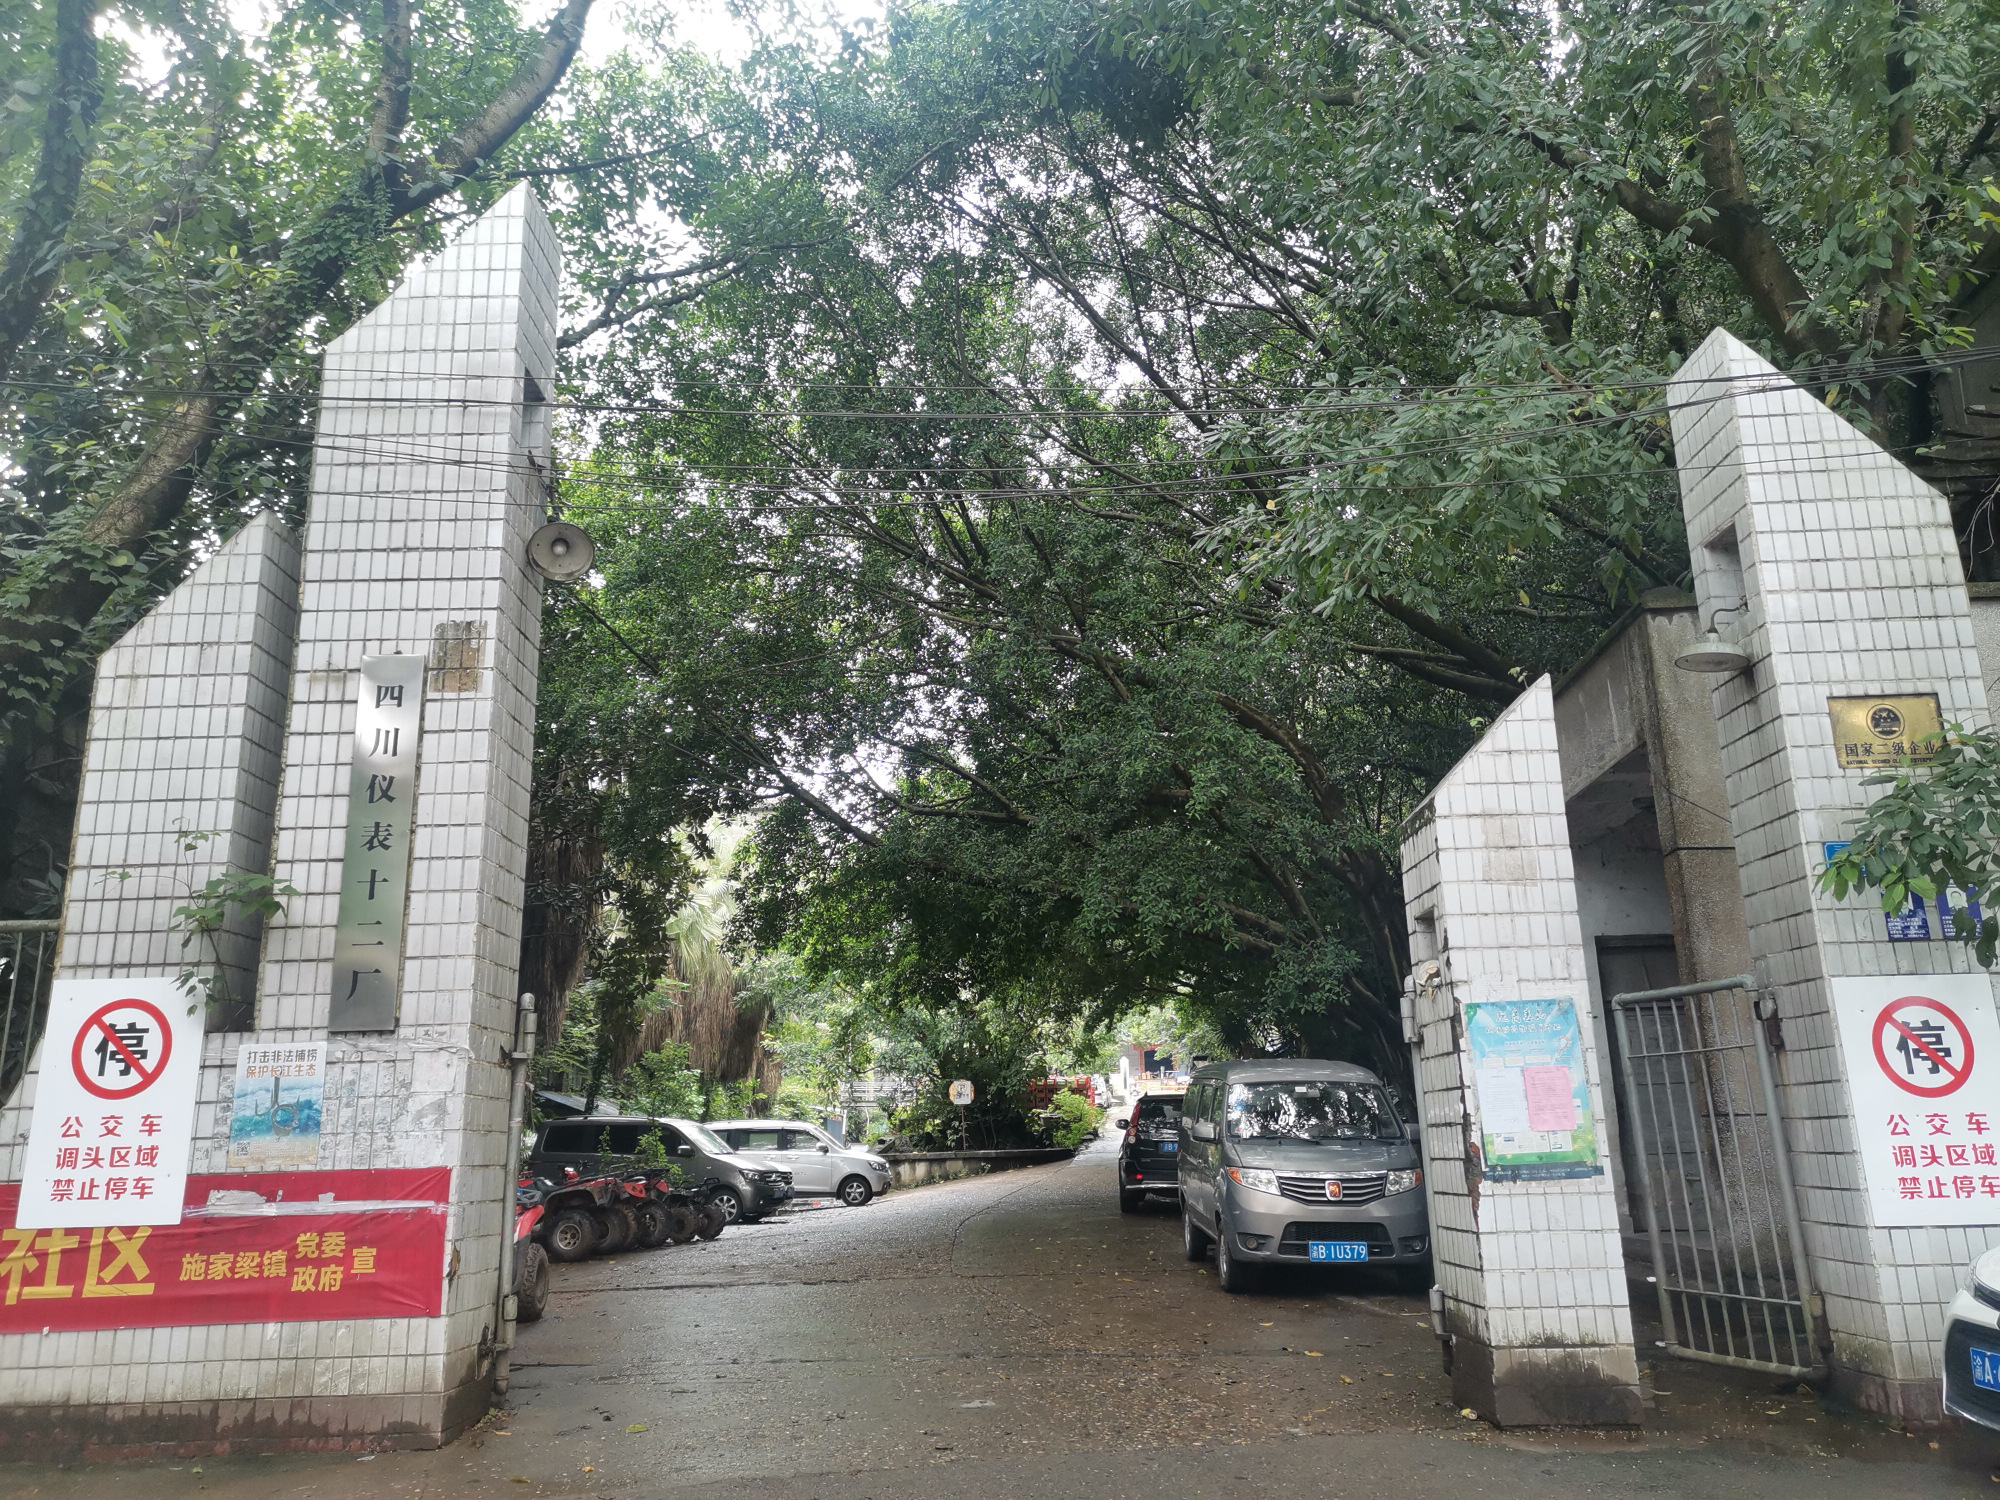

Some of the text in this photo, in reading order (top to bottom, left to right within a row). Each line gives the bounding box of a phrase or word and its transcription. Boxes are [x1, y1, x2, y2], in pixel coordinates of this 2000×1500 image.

[1844, 741, 1936, 758] 国家二级企业
[346, 683, 405, 1001] 四川仪表十二厂
[247, 1048, 318, 1064] 打击非法捕捞
[246, 1063, 316, 1079] 保护长江生态
[60, 1113, 163, 1139] 公交车
[1886, 1112, 1990, 1137] 公交车
[55, 1144, 160, 1170] 调头区域
[1891, 1144, 1998, 1169] 调头区域
[50, 1176, 155, 1202] 禁止停车
[1897, 1174, 2000, 1200] 禁止停车
[295, 1231, 347, 1259] 党委
[0, 1226, 156, 1305] 社区
[179, 1250, 288, 1282] 施家梁镇
[350, 1245, 378, 1275] 宣
[291, 1263, 344, 1293] 政府
